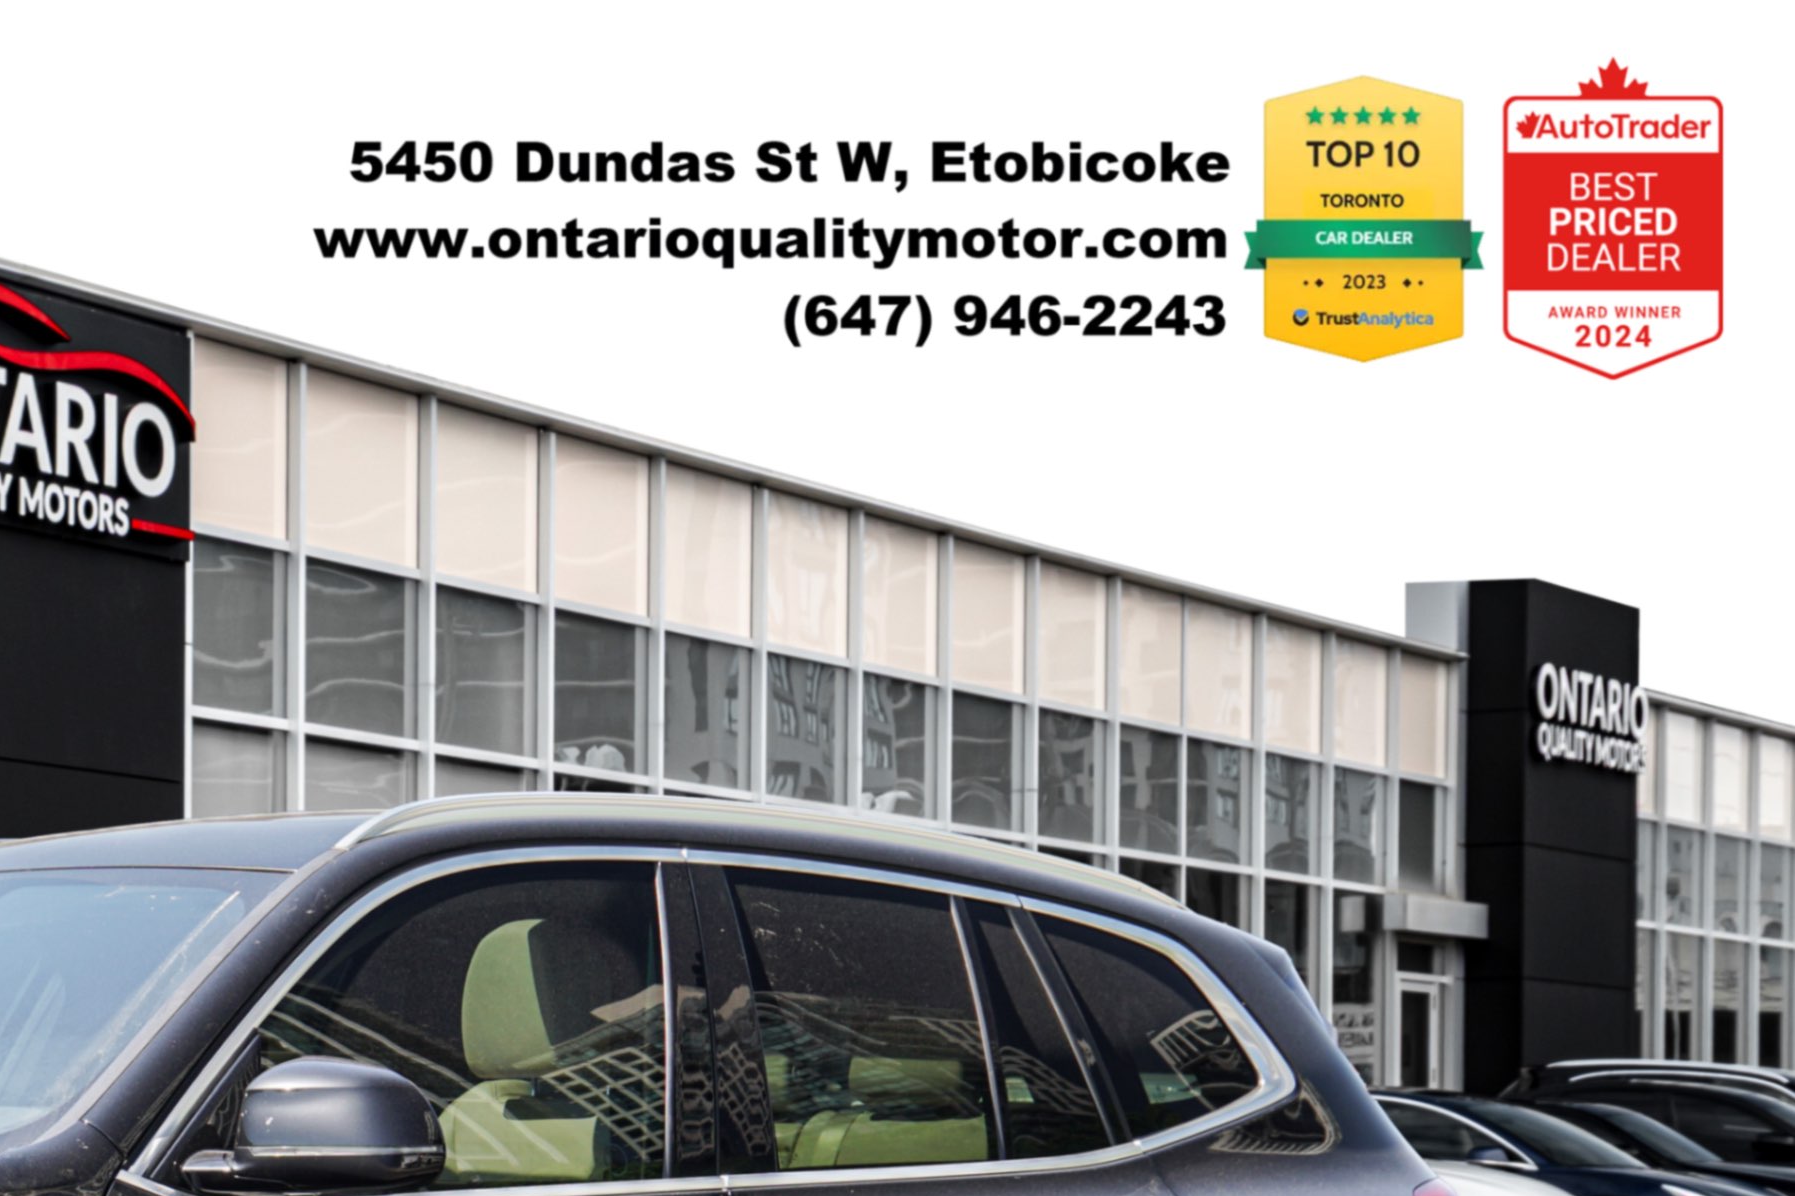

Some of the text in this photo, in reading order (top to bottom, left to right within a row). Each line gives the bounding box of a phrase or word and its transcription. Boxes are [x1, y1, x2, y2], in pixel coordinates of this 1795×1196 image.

[18, 475, 131, 537] MOTORS
[1536, 661, 1649, 739] ONTARIO
[1536, 721, 1594, 762] QUALITY
